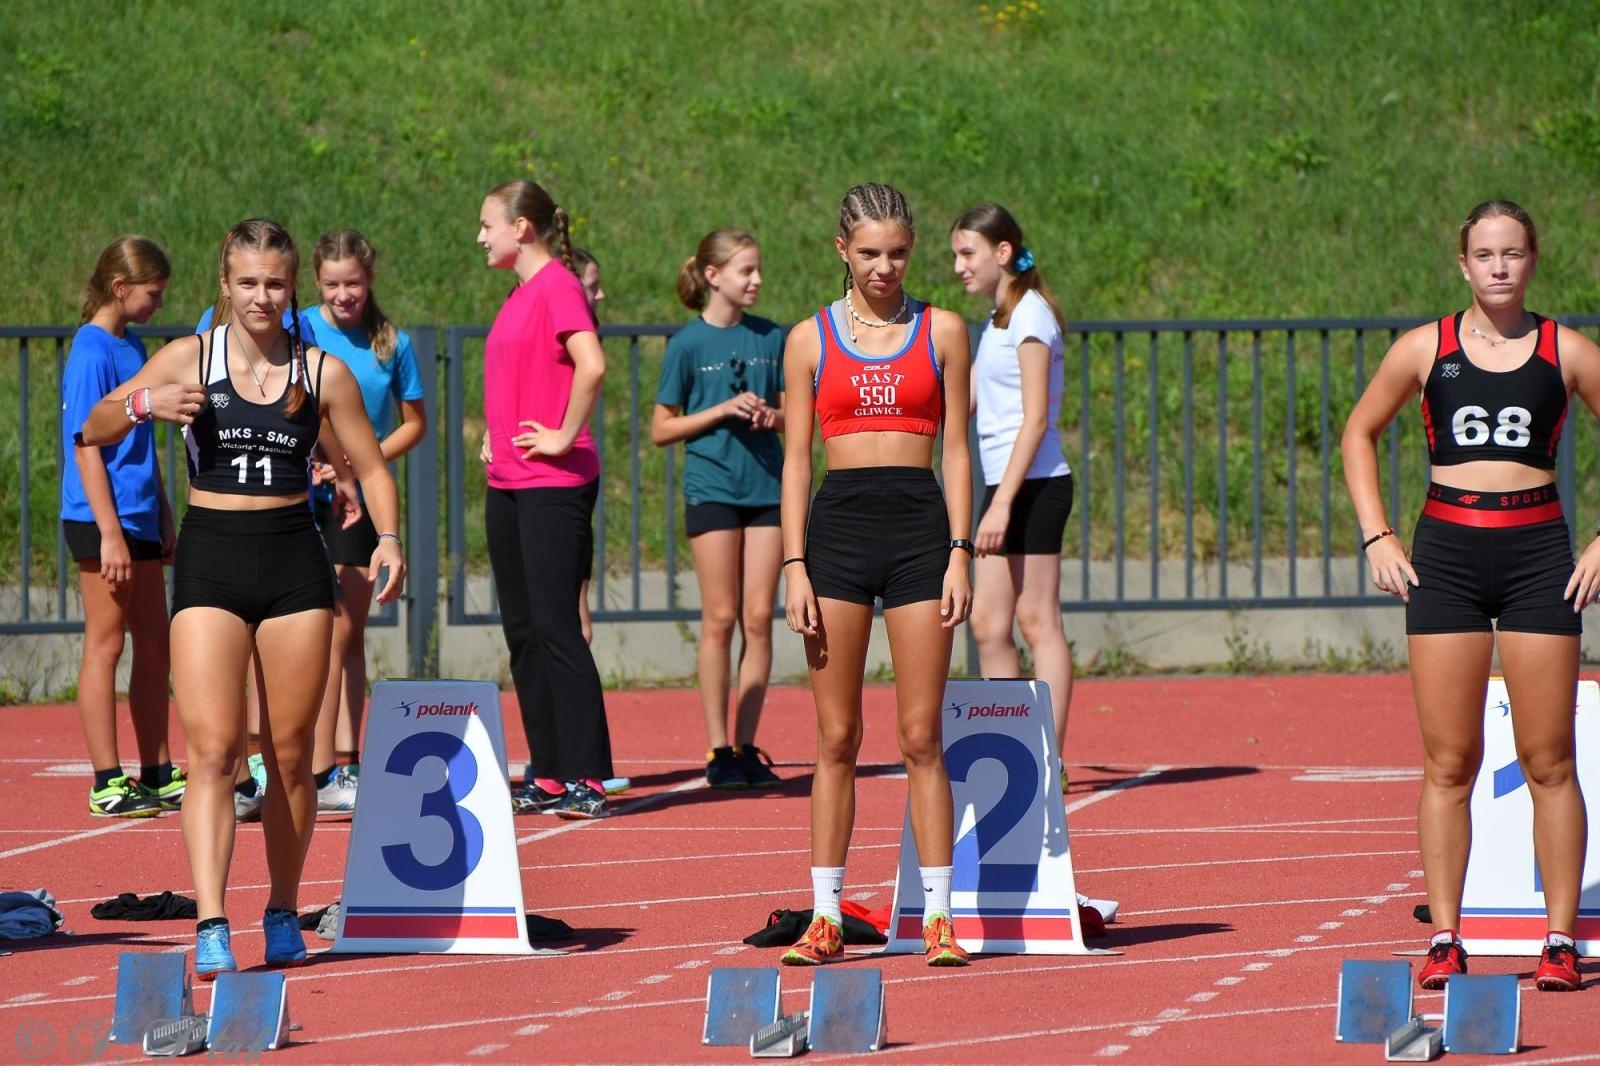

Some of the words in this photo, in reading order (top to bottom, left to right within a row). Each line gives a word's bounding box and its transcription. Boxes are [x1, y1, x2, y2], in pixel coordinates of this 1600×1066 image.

[850, 372, 905, 387] PIAST
[859, 385, 896, 406] 550
[854, 407, 903, 417] GLIWICE
[1452, 405, 1532, 448] 68
[218, 427, 252, 440] MKS
[266, 431, 298, 448] SMS
[231, 453, 272, 486] 11
[1500, 490, 1549, 507] SPORT
[416, 701, 479, 719] polanik
[967, 703, 1031, 720] polanik
[381, 731, 484, 891] 3
[943, 732, 1039, 893] 2
